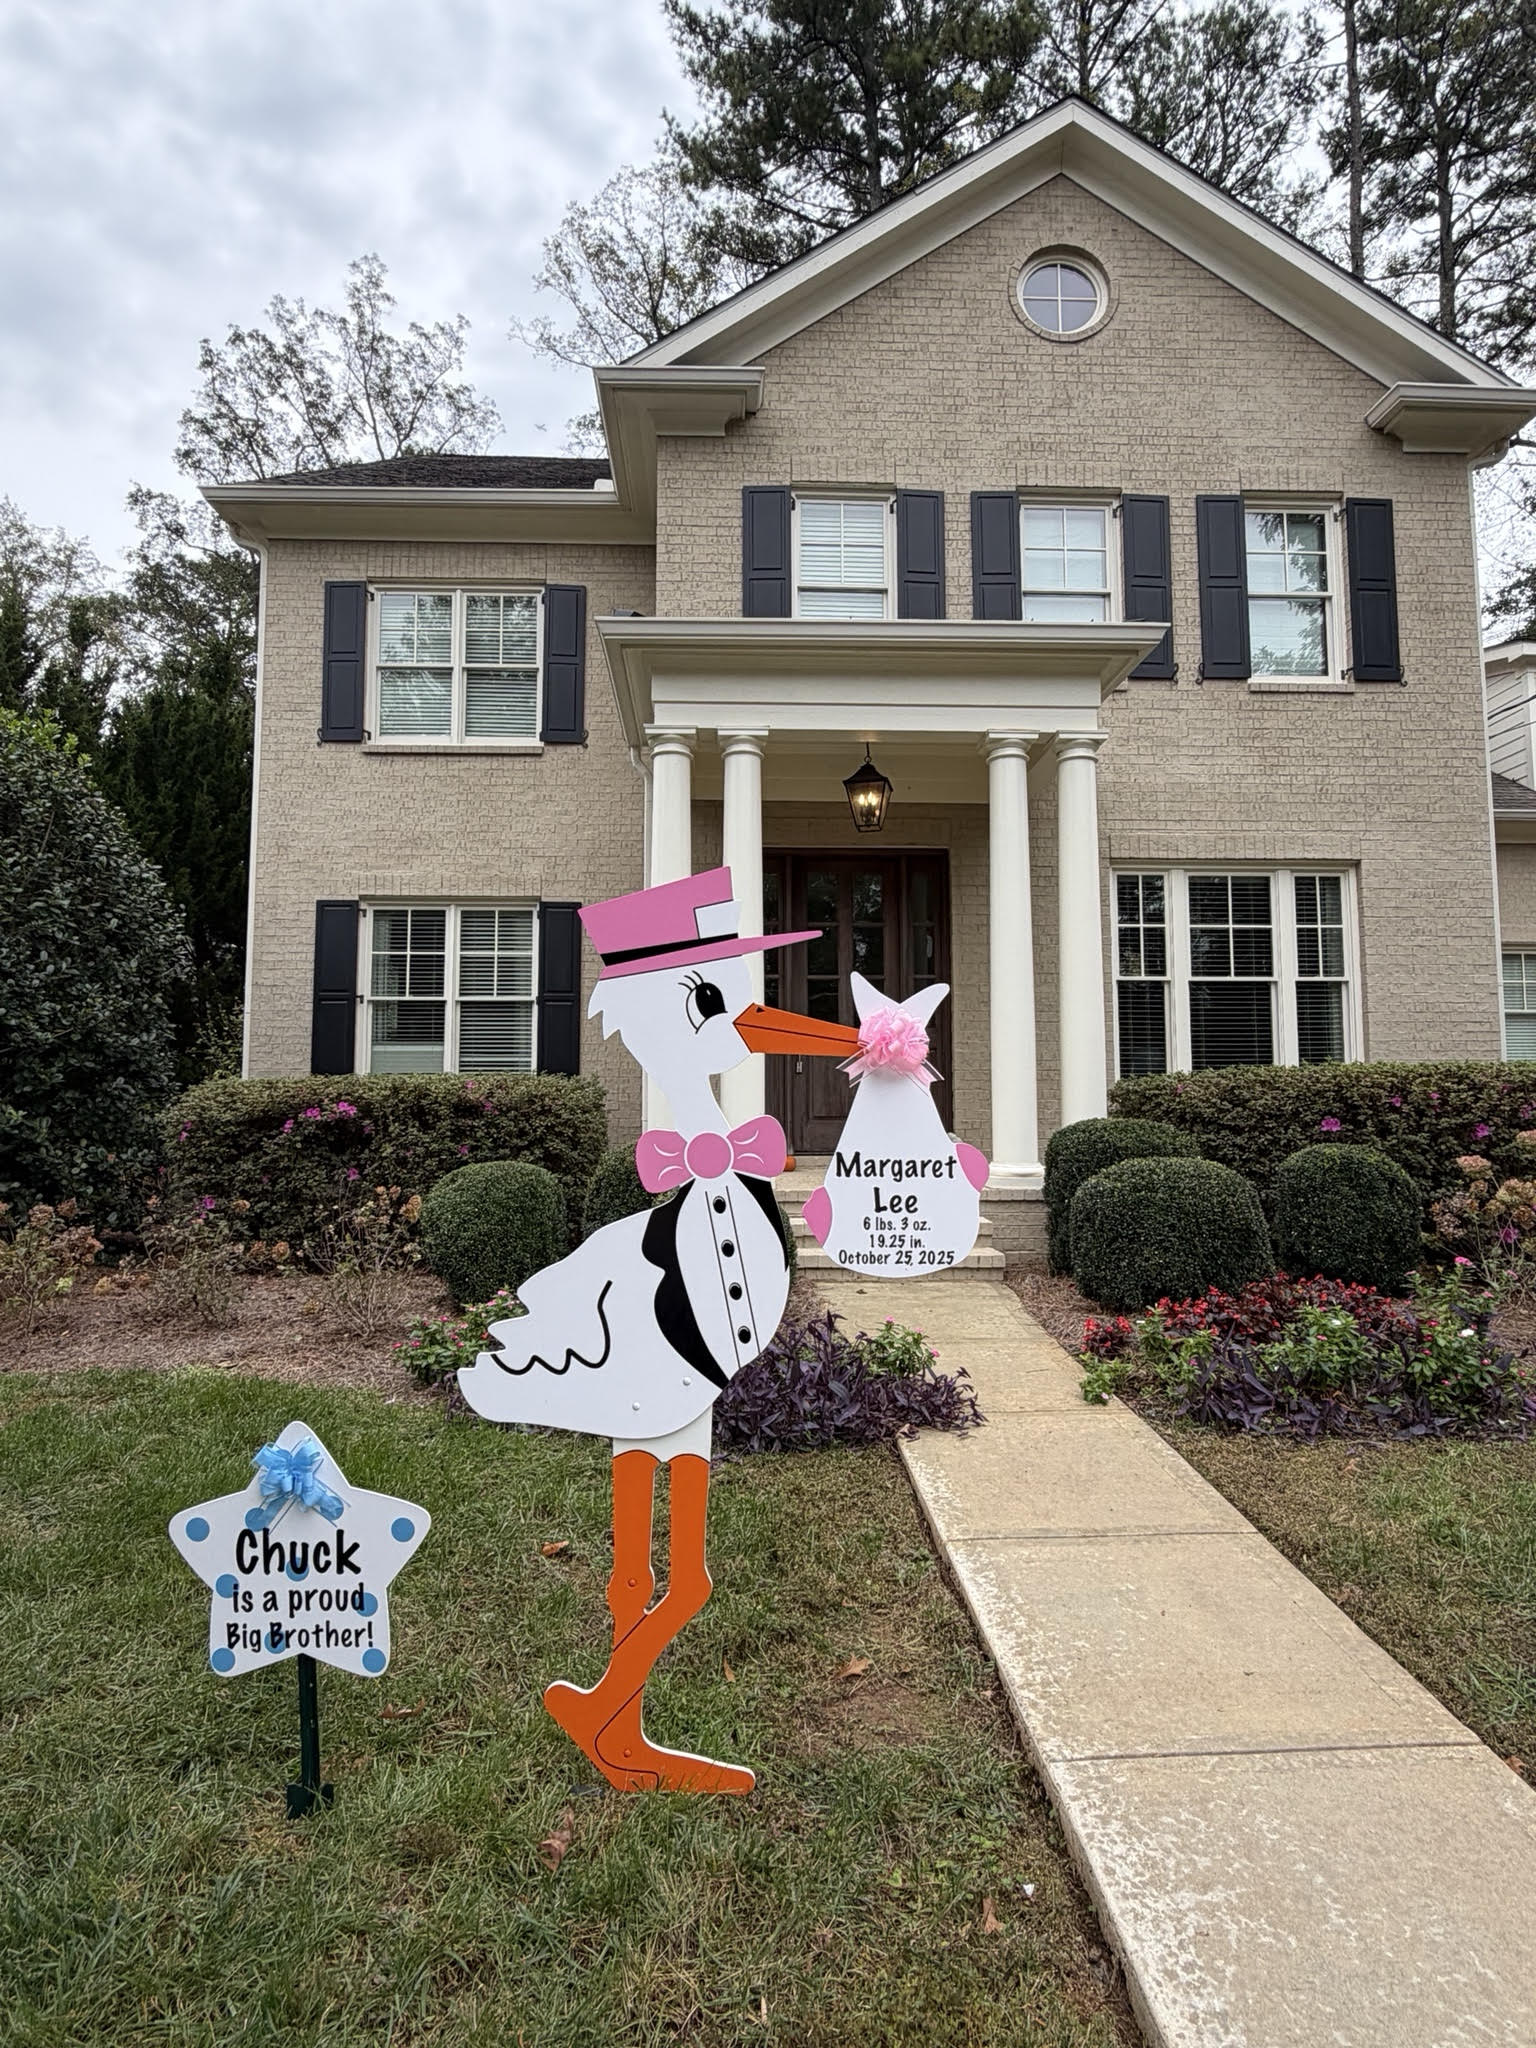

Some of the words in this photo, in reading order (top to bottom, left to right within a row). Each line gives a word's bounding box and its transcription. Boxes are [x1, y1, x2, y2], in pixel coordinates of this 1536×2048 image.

[836, 1151, 957, 1182] Margaret
[873, 1186, 919, 1213] Lee
[863, 1216, 871, 1231] 6
[875, 1216, 896, 1231] lbs.
[900, 1216, 909, 1231] 3
[913, 1220, 931, 1231] oz.
[869, 1234, 906, 1248] 19.25
[910, 1234, 925, 1248] in.
[839, 1250, 890, 1265] October
[895, 1250, 914, 1266] 25,
[918, 1250, 955, 1265] 2025
[235, 1527, 361, 1575] Chuck
[232, 1583, 254, 1613] is
[262, 1590, 279, 1612] a
[288, 1582, 365, 1618] proud
[226, 1622, 262, 1653] Big
[269, 1620, 374, 1650] Brother!
